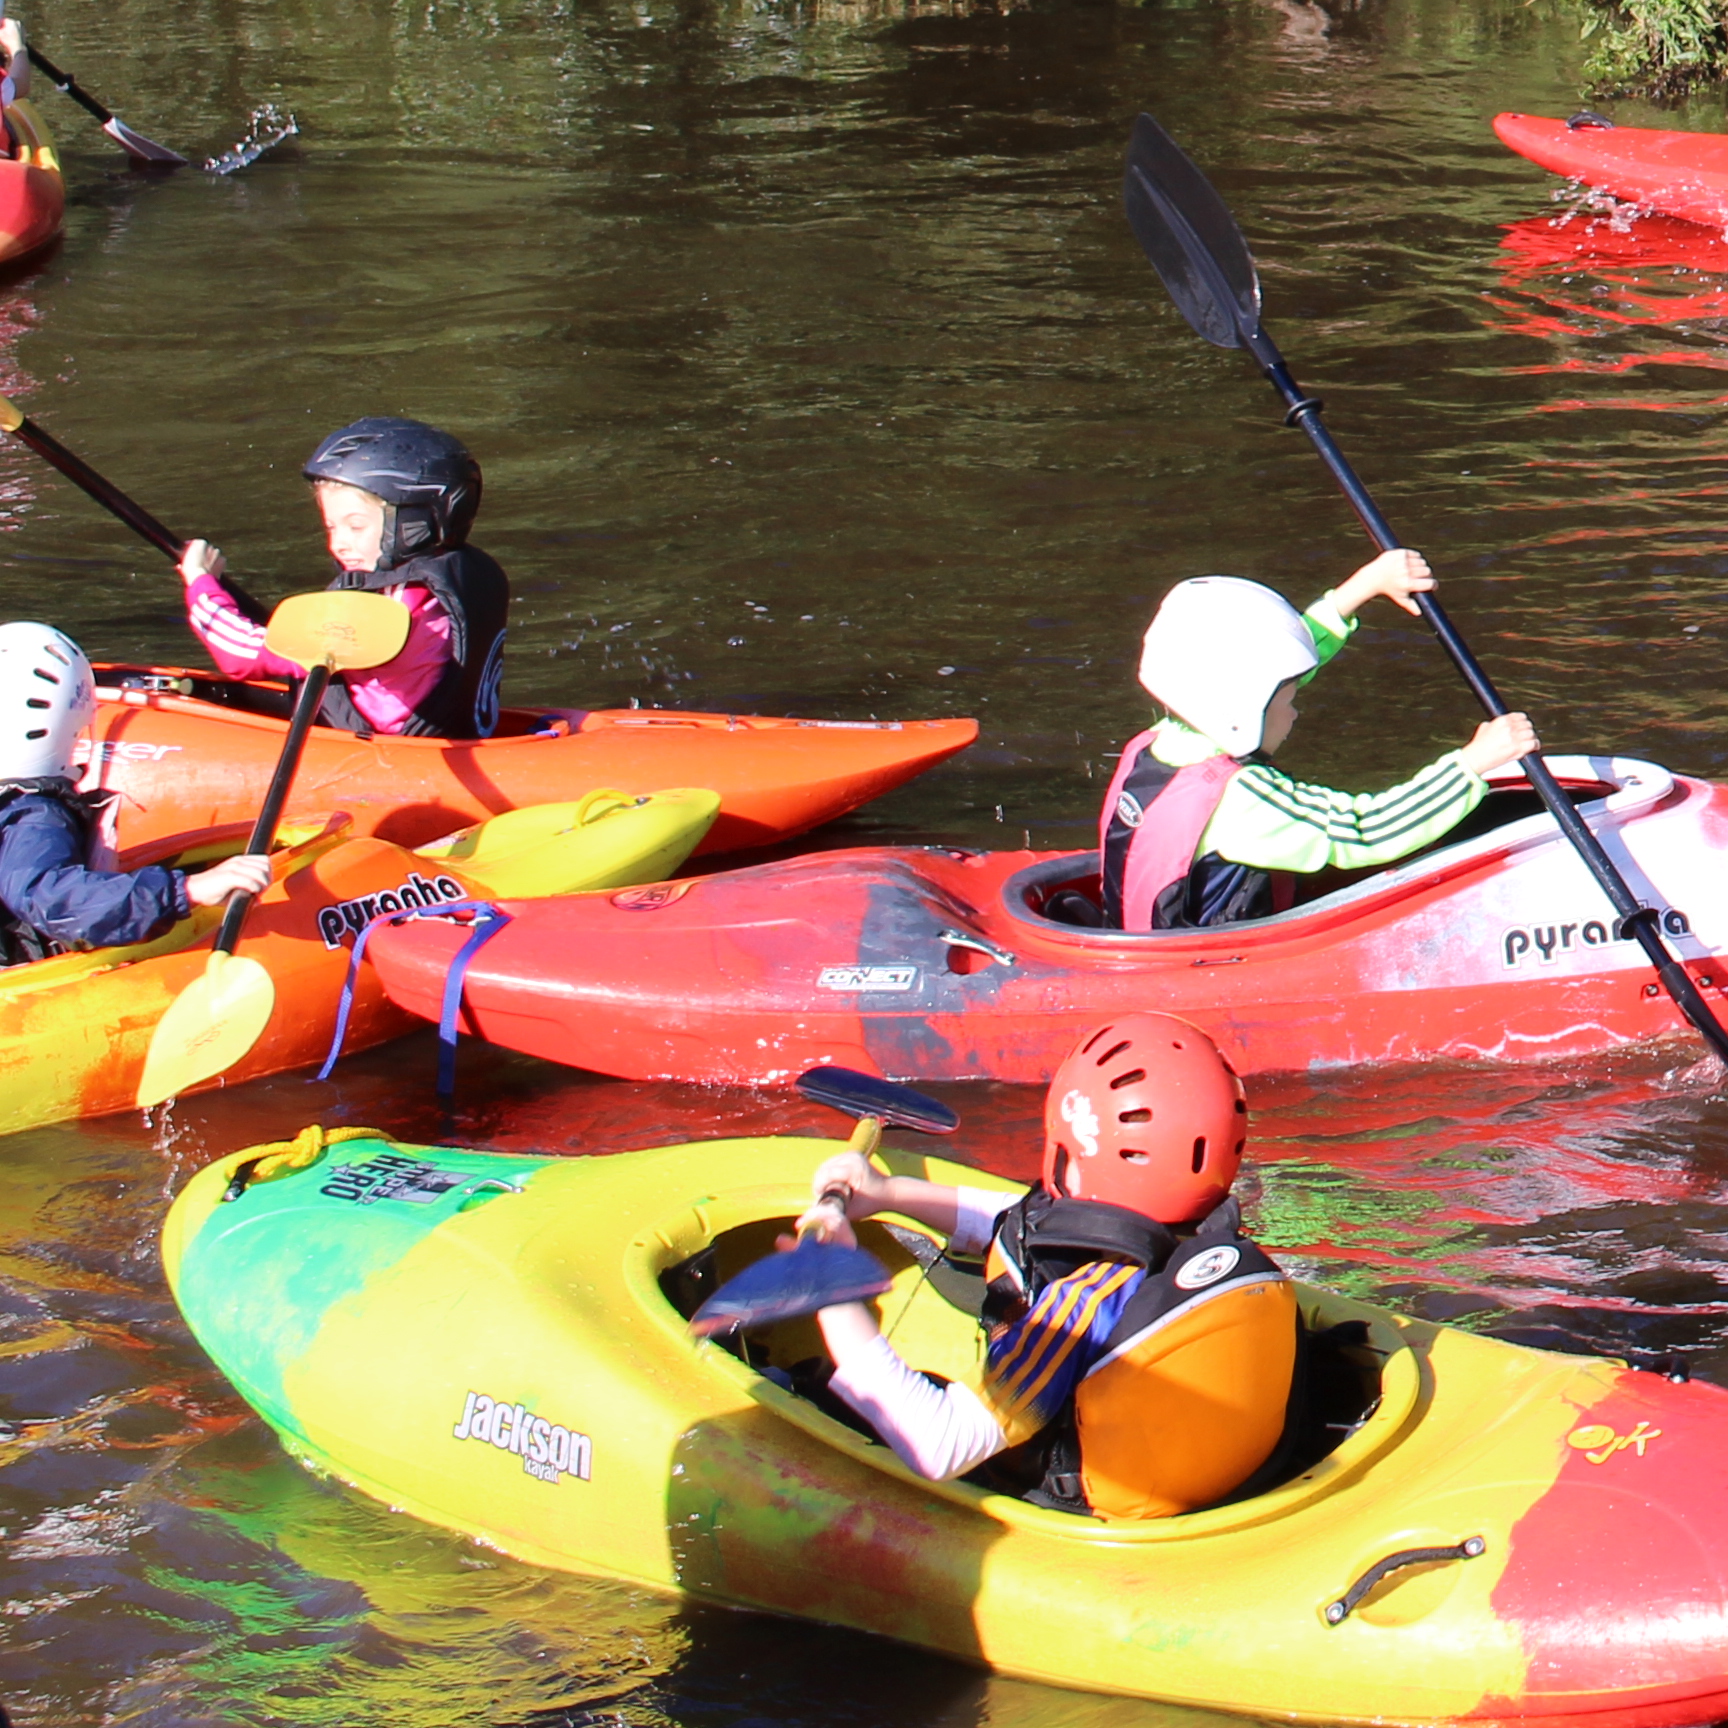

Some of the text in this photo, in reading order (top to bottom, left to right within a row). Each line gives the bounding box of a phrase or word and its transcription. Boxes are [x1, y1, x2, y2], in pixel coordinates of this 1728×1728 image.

[319, 873, 467, 950] pyranha
[1504, 901, 1690, 965] pyraa
[320, 1154, 419, 1200] HERO
[453, 1389, 592, 1482] jackson
[523, 1455, 560, 1485] kayak
